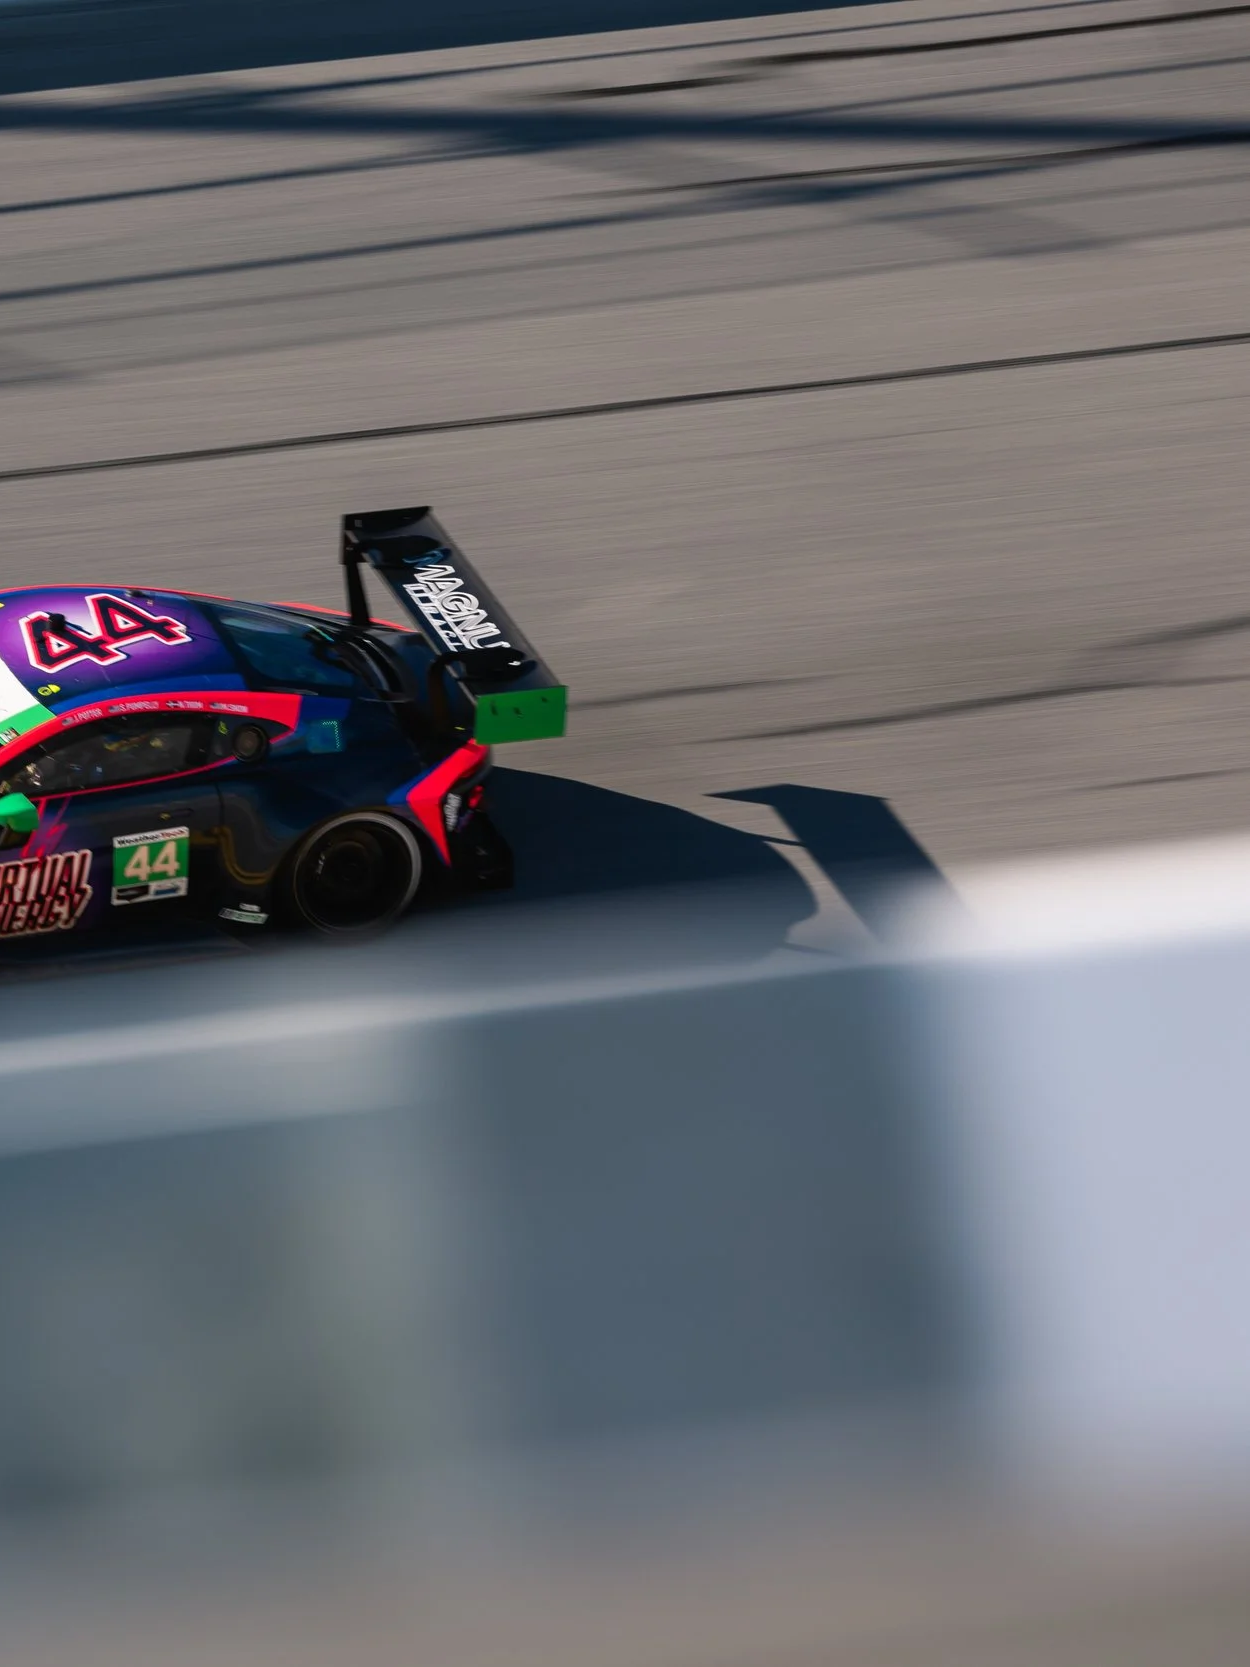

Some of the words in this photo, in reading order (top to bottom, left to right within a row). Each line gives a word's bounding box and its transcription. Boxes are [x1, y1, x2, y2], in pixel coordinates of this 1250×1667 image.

[19, 593, 192, 674] 44
[402, 550, 512, 650] MAGNU
[124, 841, 180, 881] 44
